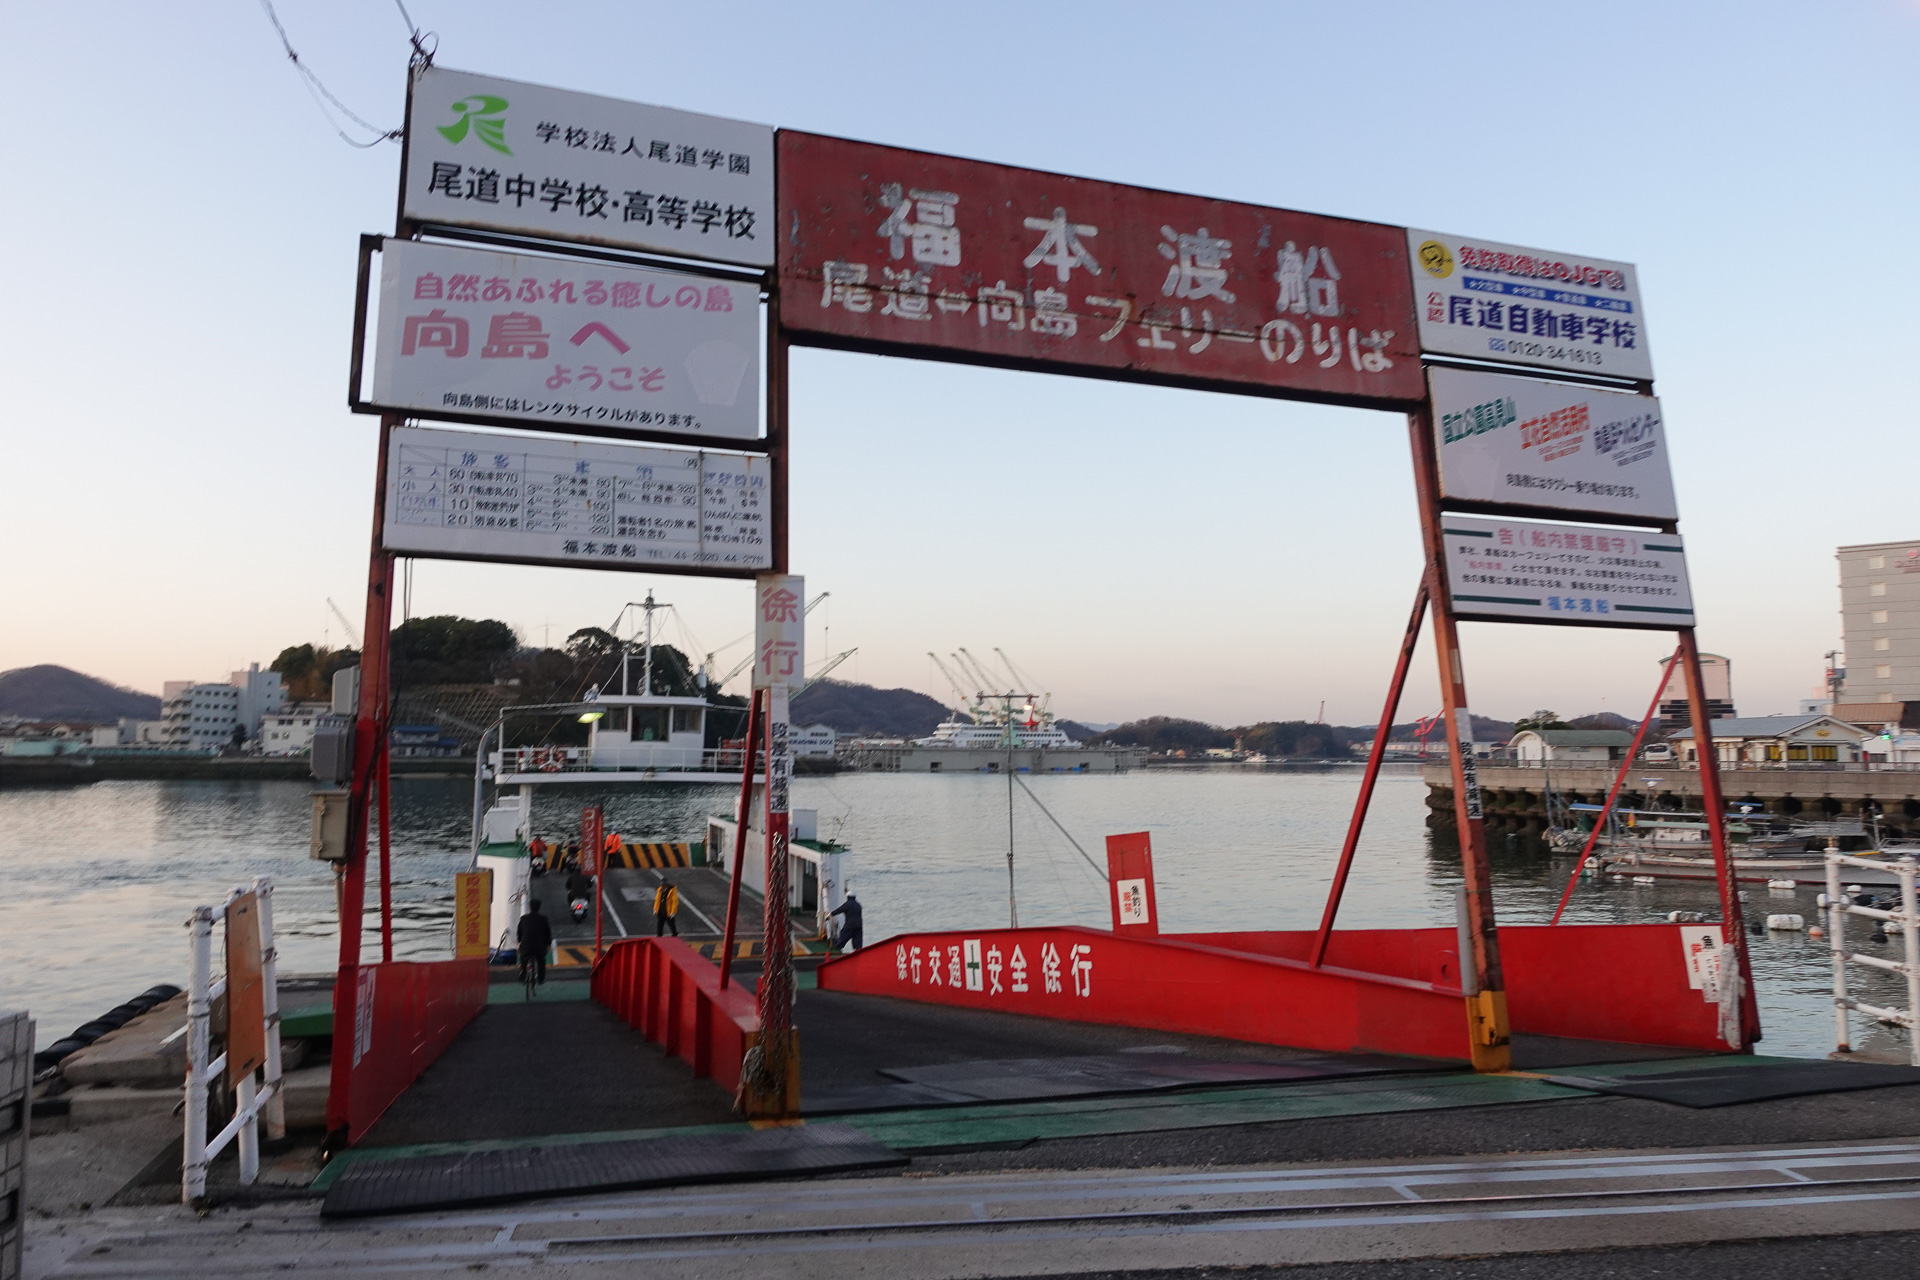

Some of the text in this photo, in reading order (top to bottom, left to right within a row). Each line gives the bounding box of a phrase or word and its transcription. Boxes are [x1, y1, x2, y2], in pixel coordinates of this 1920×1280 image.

[536, 120, 751, 176] 学校法人尾道学園
[427, 160, 757, 240] 尾道中学校・高等学校
[878, 181, 1342, 317] 福本渡船
[414, 271, 734, 313] 自然あふれる癒しの島
[1427, 291, 1445, 324] 公認
[401, 308, 632, 360] 向島へ
[820, 260, 1395, 373] 尾道 向島フェリーのりば
[1448, 295, 1637, 349] 尾道自動車学校
[545, 364, 666, 392] ようこそ
[442, 391, 702, 430] 向島側にはレンタサイクルがあります。
[447, 514, 468, 526] 20
[450, 498, 469, 512] 10
[562, 540, 637, 558] 福本渡船
[1547, 595, 1610, 614] 福本渡船
[761, 586, 799, 676] 徐行
